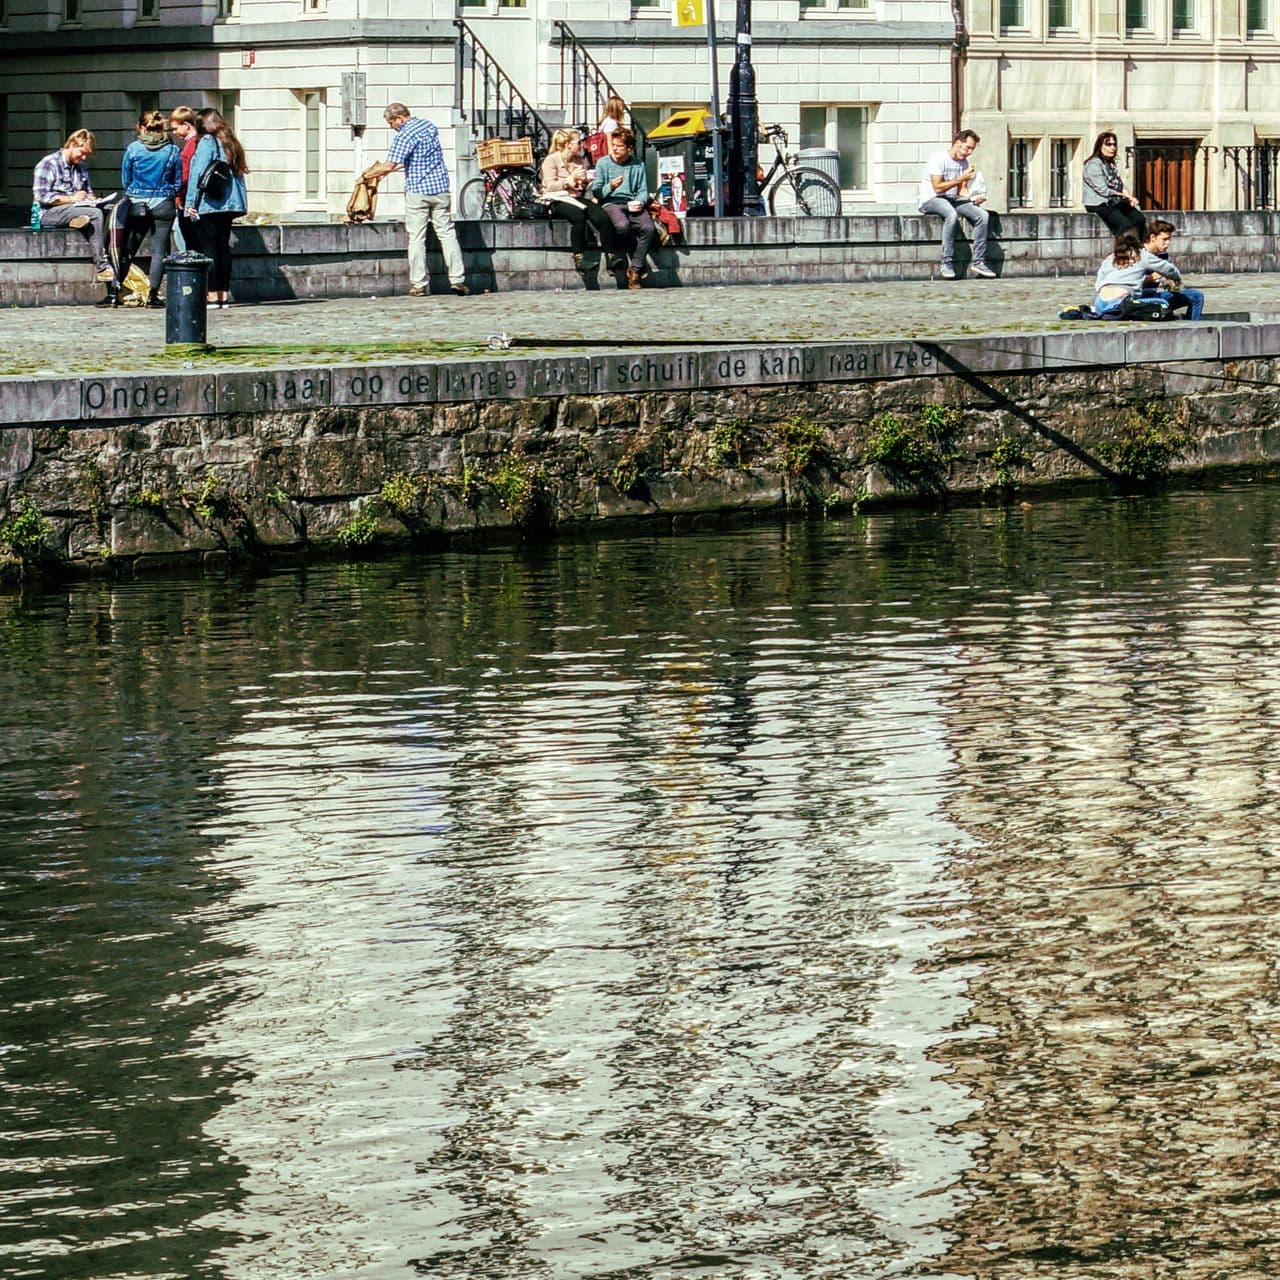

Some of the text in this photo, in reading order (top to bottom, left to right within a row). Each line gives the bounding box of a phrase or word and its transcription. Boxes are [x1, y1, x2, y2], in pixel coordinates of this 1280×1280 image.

[349, 374, 383, 400] op
[399, 370, 430, 395] de
[718, 355, 747, 379] de
[829, 349, 882, 374] naar
[894, 346, 934, 370] zee
